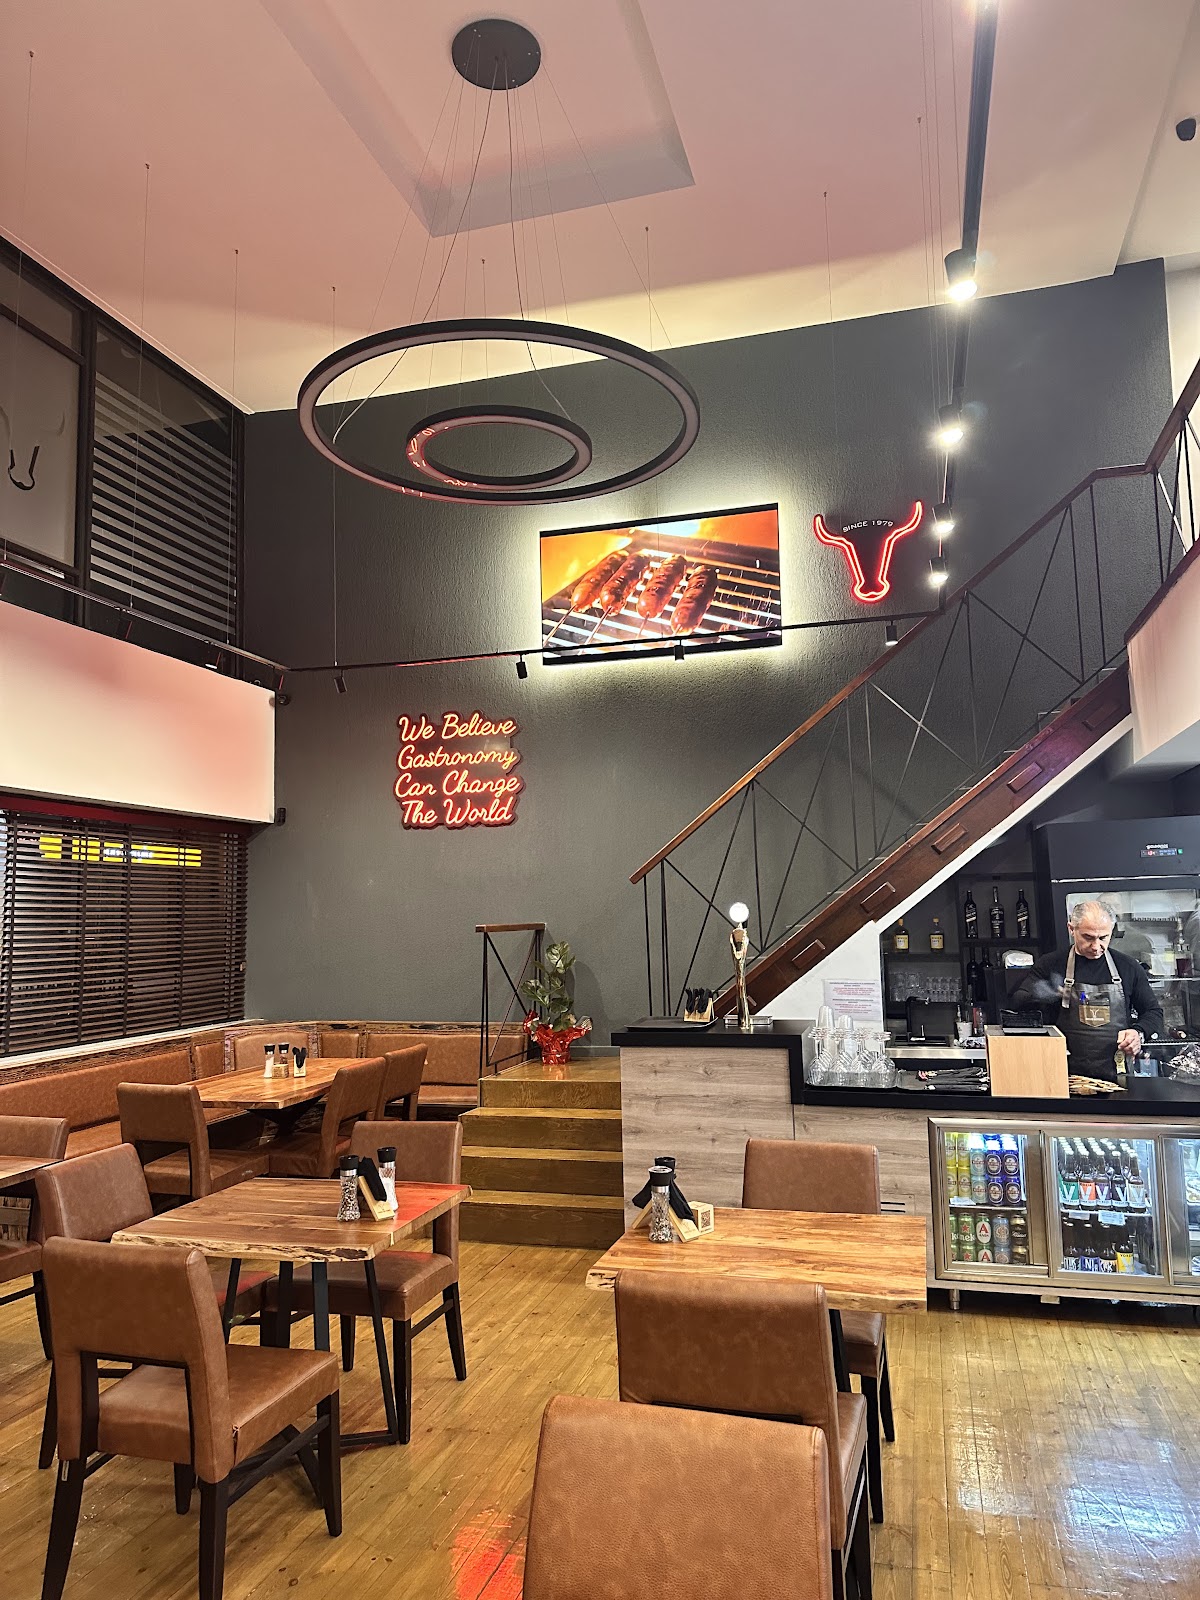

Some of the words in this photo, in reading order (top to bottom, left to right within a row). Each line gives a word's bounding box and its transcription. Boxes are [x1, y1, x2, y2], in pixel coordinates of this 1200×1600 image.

[843, 521, 868, 532] SINCE
[399, 716, 435, 742] We
[441, 712, 517, 740] Believe
[397, 744, 518, 770] Gastronomy
[395, 772, 437, 798] Can
[442, 769, 520, 798] Change
[401, 799, 438, 824] The
[443, 796, 514, 825] World
